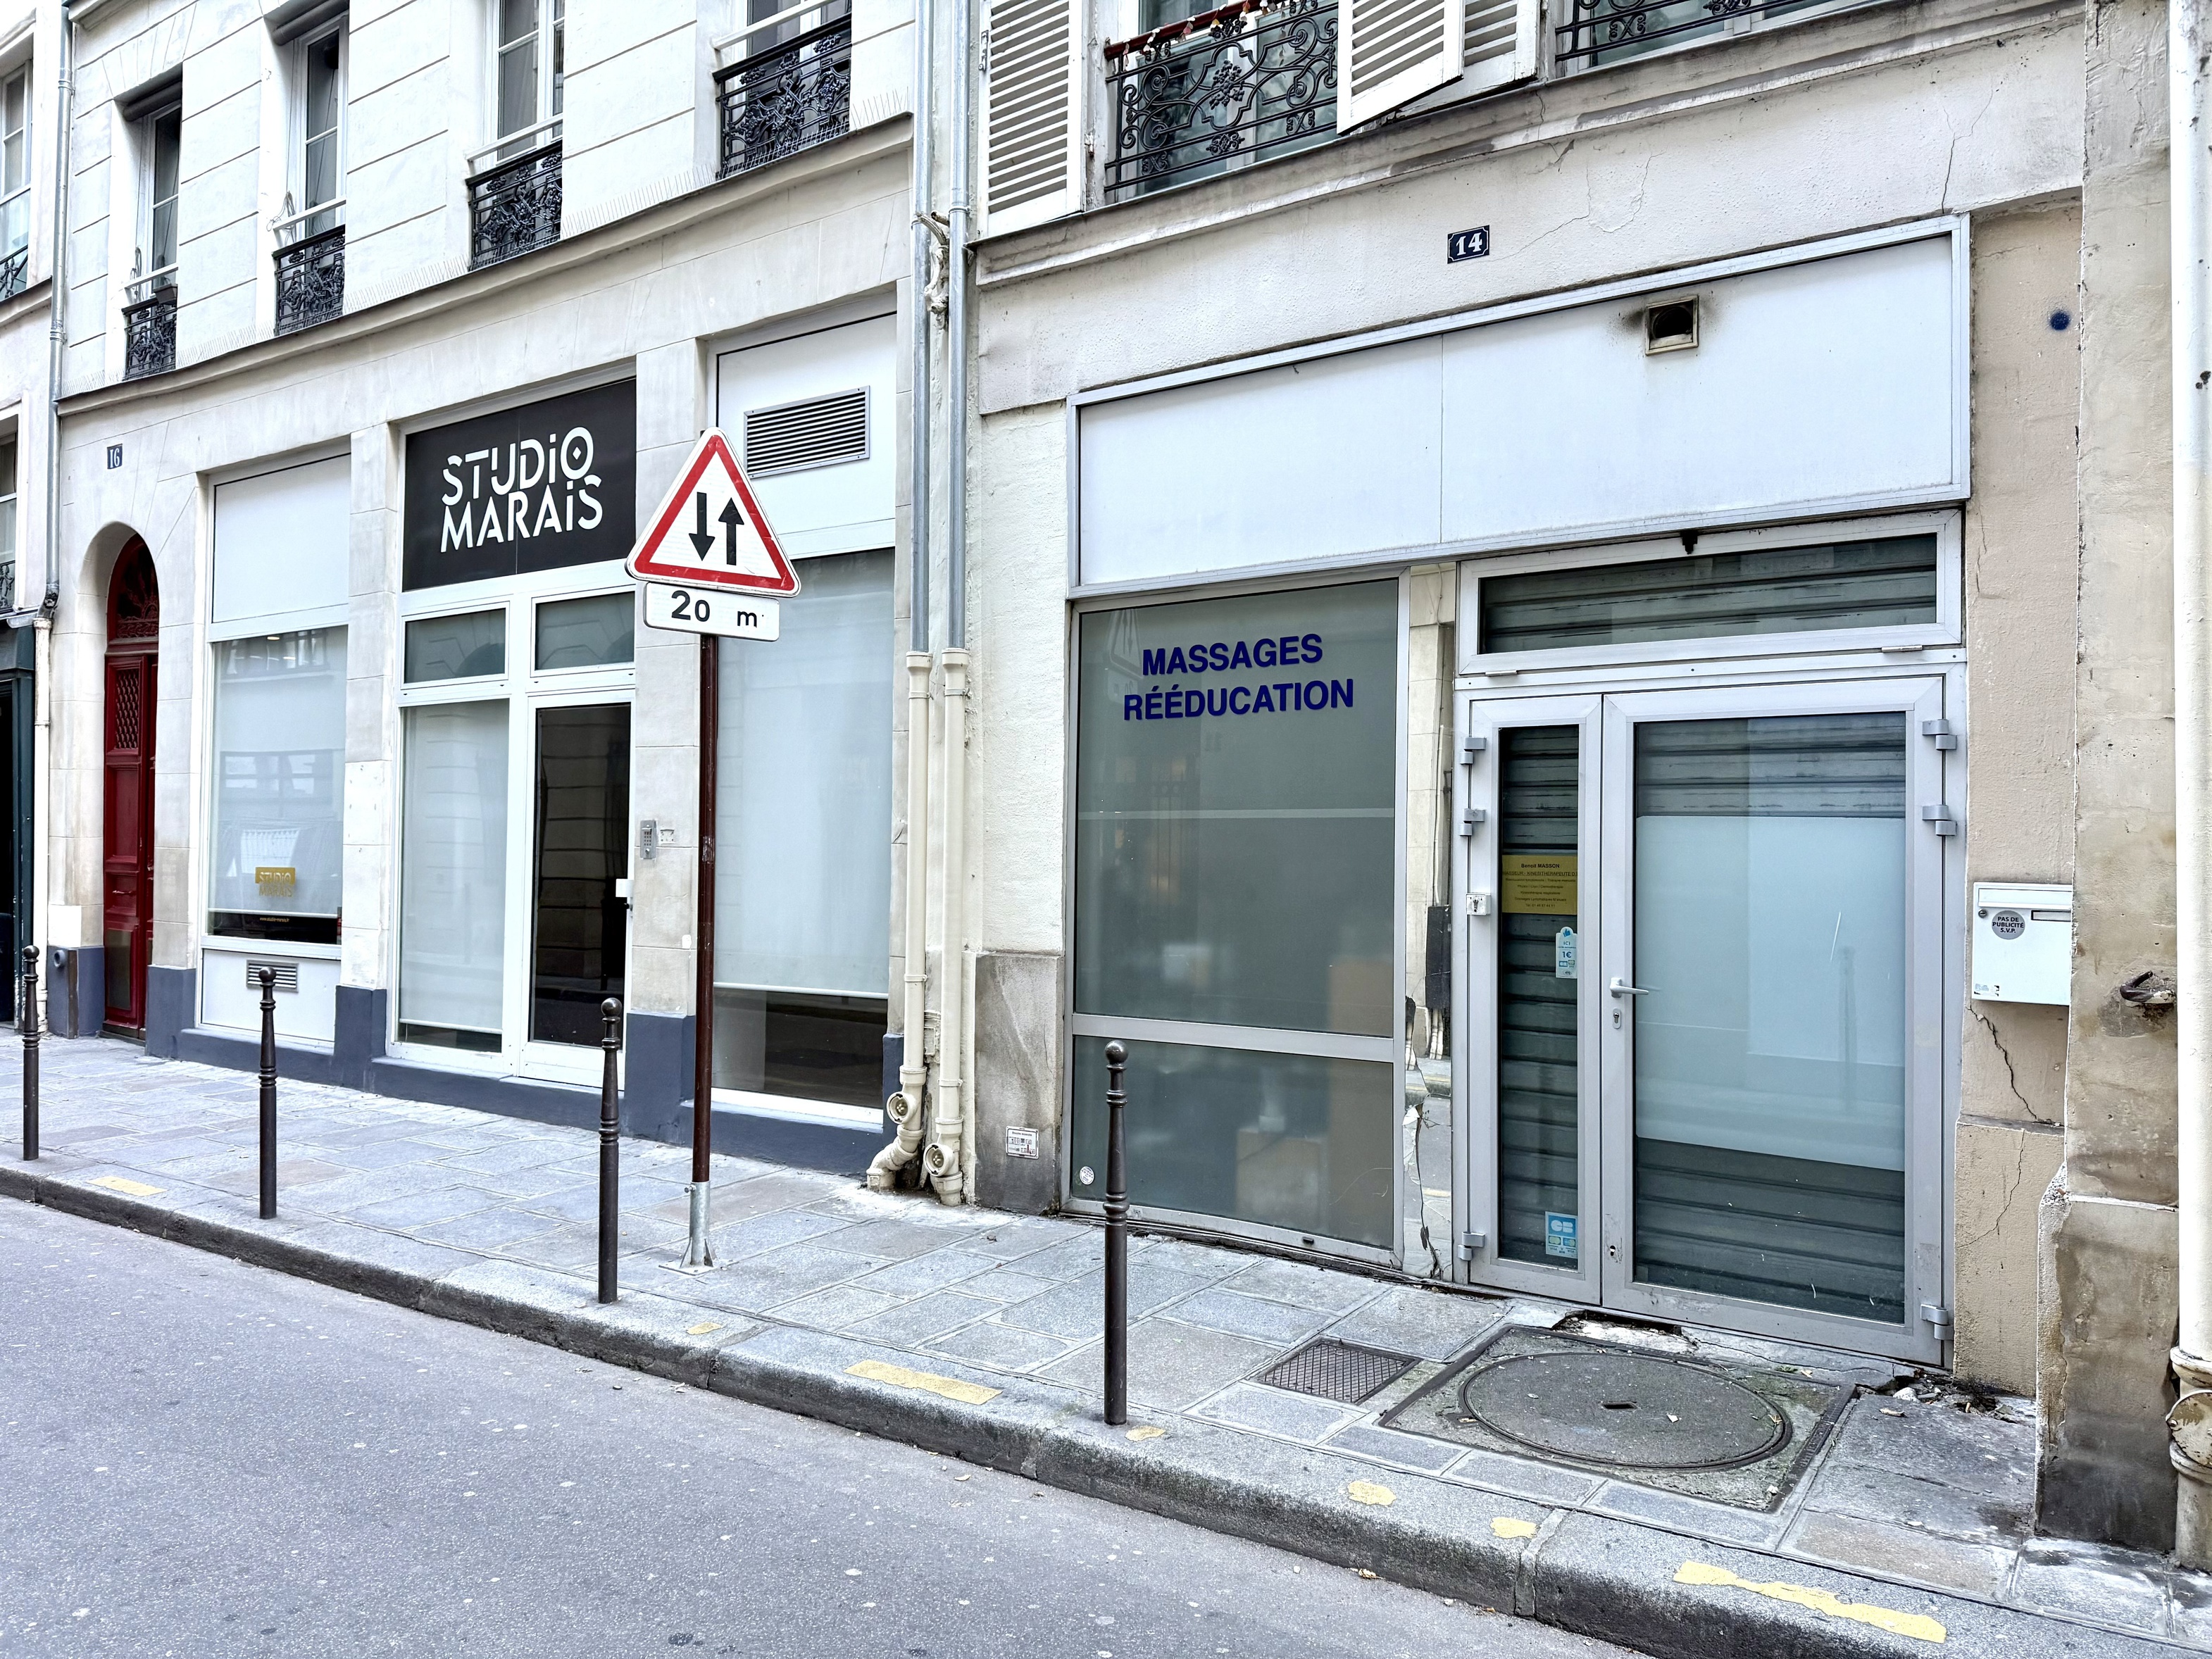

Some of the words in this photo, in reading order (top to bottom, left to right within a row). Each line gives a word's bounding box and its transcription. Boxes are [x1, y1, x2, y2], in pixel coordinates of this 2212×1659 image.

[1456, 232, 1482, 256] 14
[110, 448, 120, 468] 16
[671, 590, 711, 622] 20
[737, 611, 758, 628] m
[1143, 634, 1323, 675] MASSAGES
[1124, 679, 1354, 720] RÉÉDUCATION
